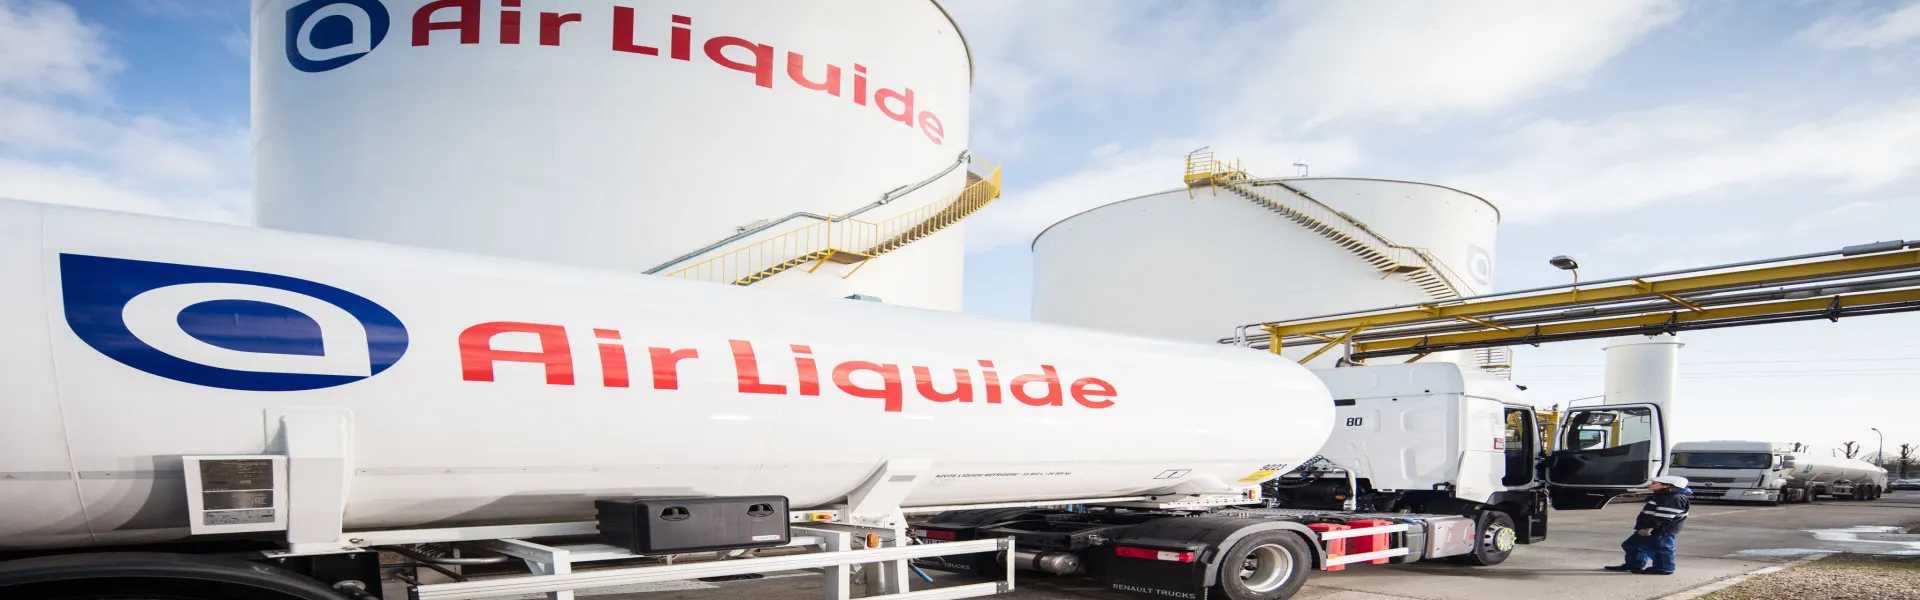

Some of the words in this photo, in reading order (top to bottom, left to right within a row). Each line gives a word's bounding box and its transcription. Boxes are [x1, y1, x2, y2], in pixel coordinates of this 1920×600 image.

[411, 0, 581, 47] Air
[611, 6, 945, 145] Liquide
[458, 321, 699, 390] Air
[727, 338, 1118, 413] Liquide
[1346, 417, 1363, 426] 80
[1112, 583, 1154, 594] RENAULT
[1155, 588, 1196, 599] TRUCKS
